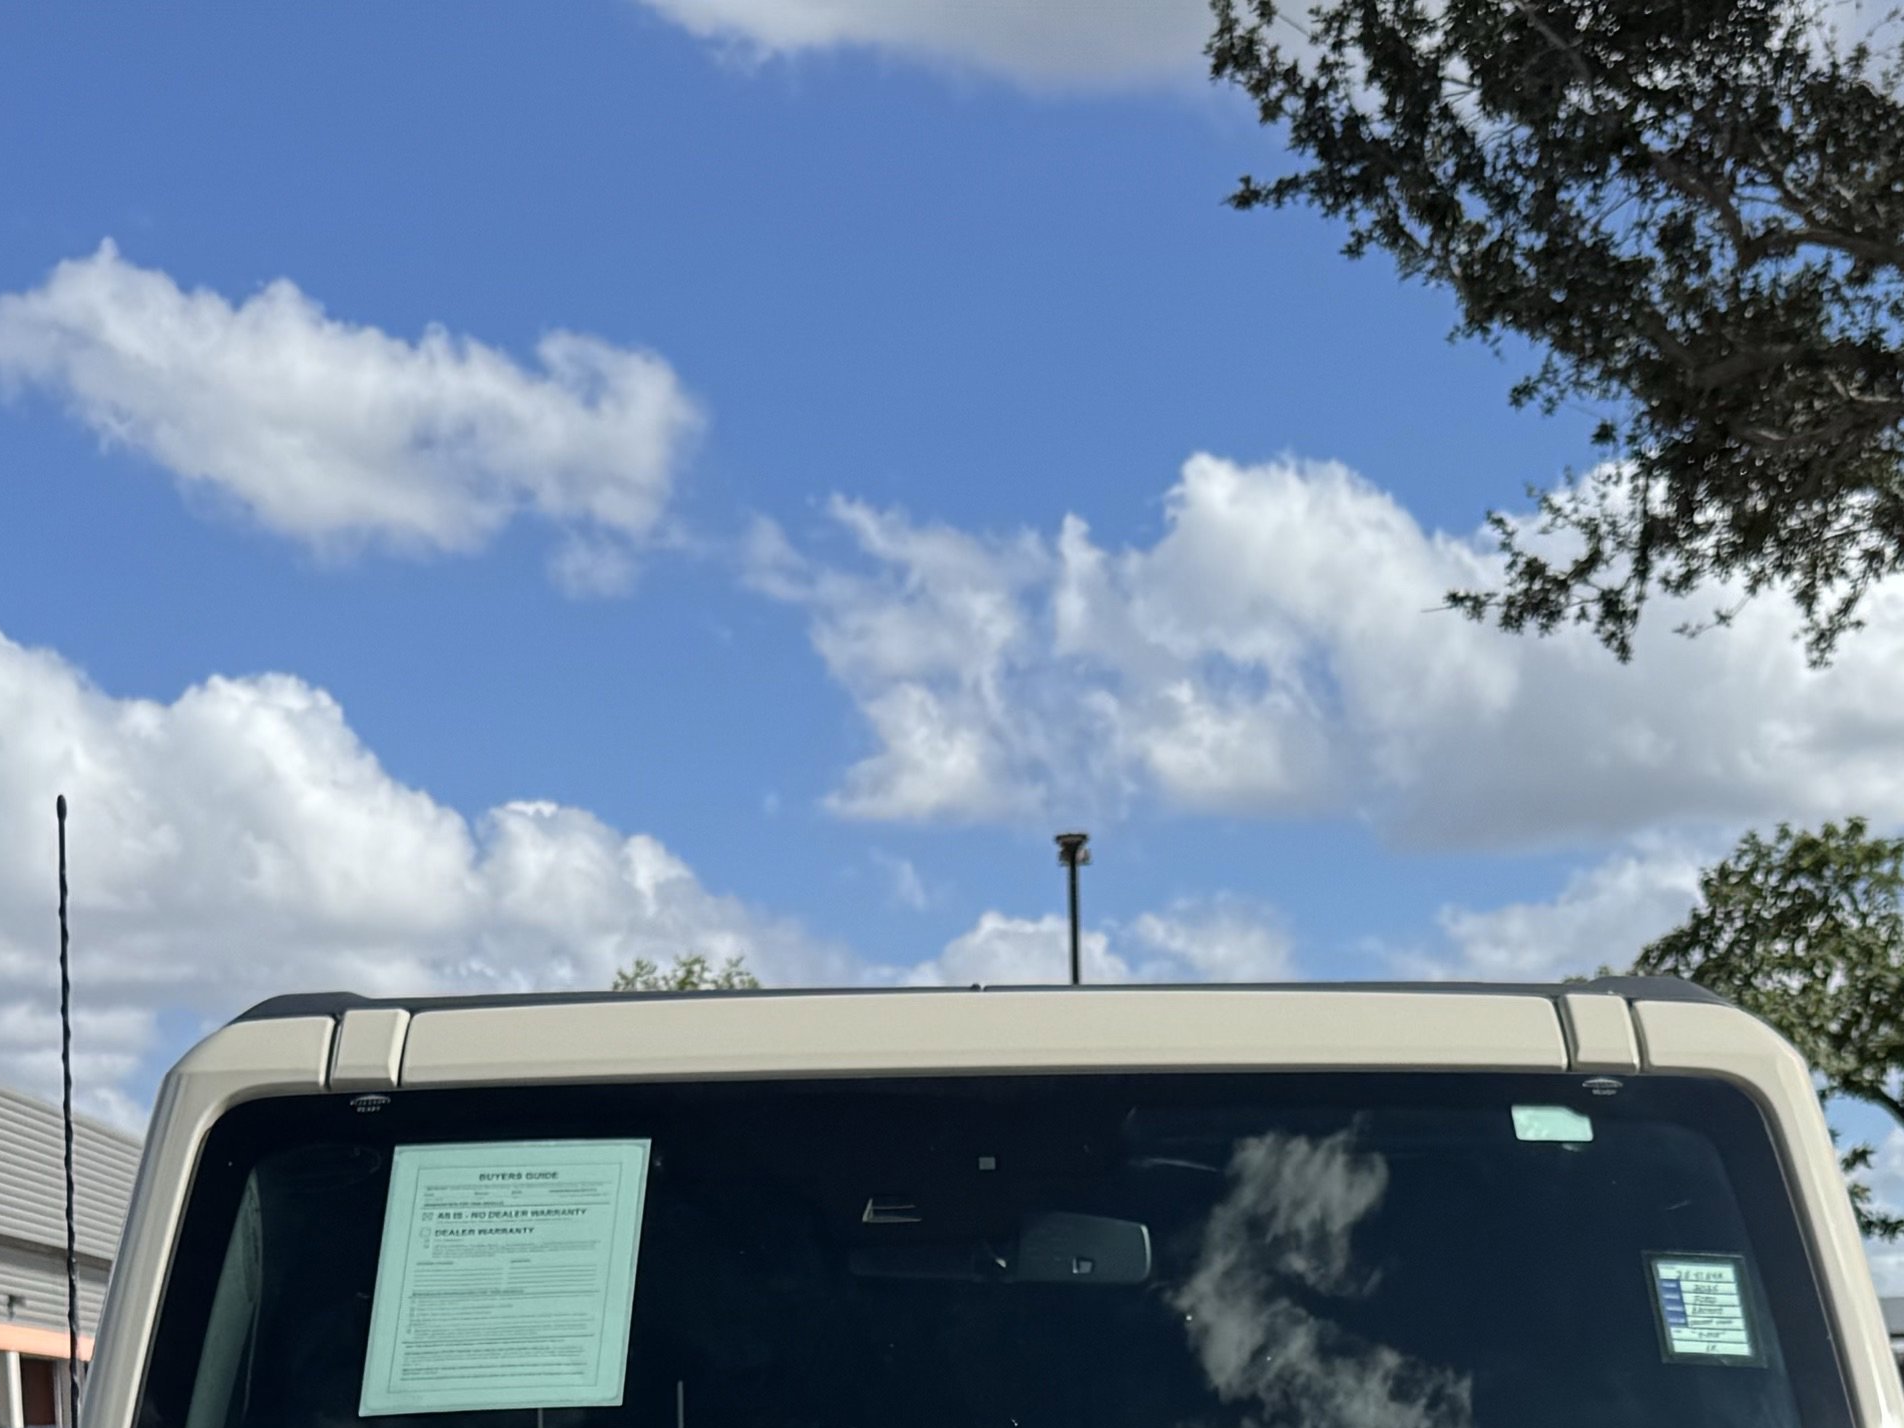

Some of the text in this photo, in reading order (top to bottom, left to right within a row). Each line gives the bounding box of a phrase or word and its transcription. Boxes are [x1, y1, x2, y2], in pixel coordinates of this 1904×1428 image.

[479, 1171, 558, 1181] BUYERS GUIDE
[437, 1211, 451, 1220] AS
[453, 1211, 463, 1219] IS
[471, 1211, 487, 1219] NO
[489, 1210, 529, 1219] DEALER
[530, 1208, 588, 1218] WARRANTY
[435, 1227, 534, 1237] DEALER WARRANTY
